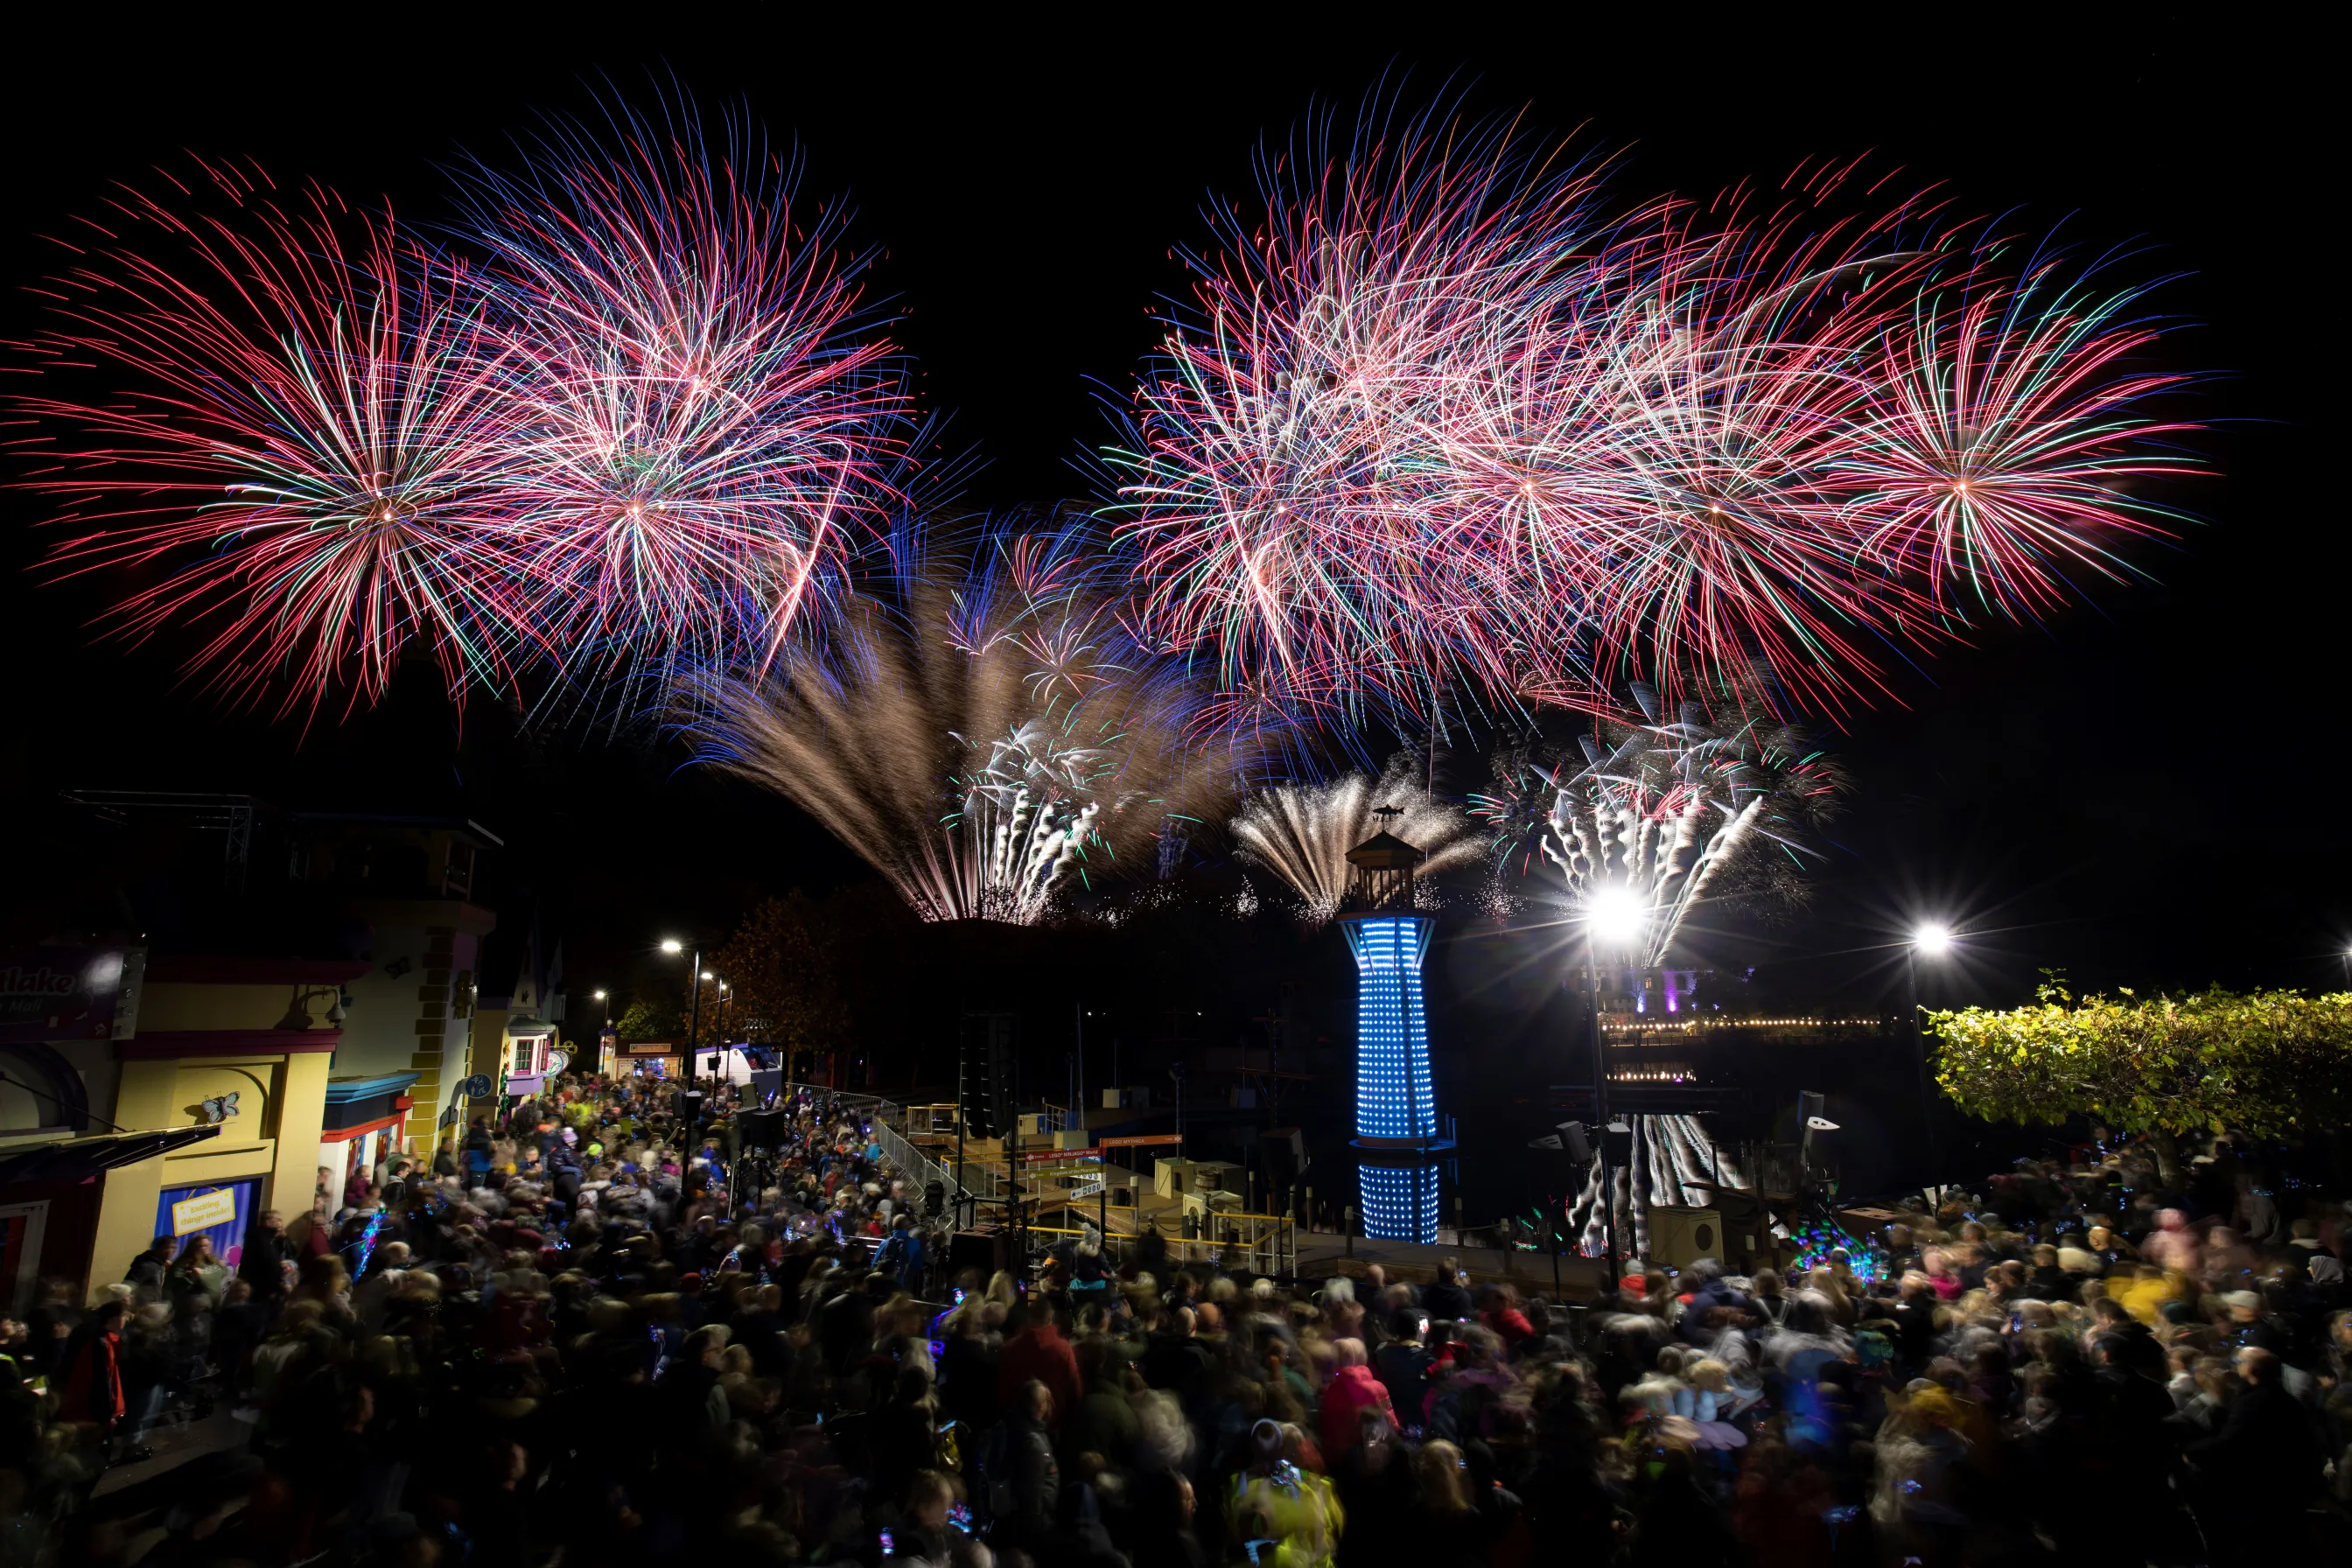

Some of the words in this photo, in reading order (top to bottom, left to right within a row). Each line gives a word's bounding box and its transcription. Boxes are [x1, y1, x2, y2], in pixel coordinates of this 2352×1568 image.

[9, 998, 44, 1013] Mall
[191, 1200, 220, 1213] Exciting
[180, 1214, 205, 1225] things
[206, 1206, 229, 1218] inside!
